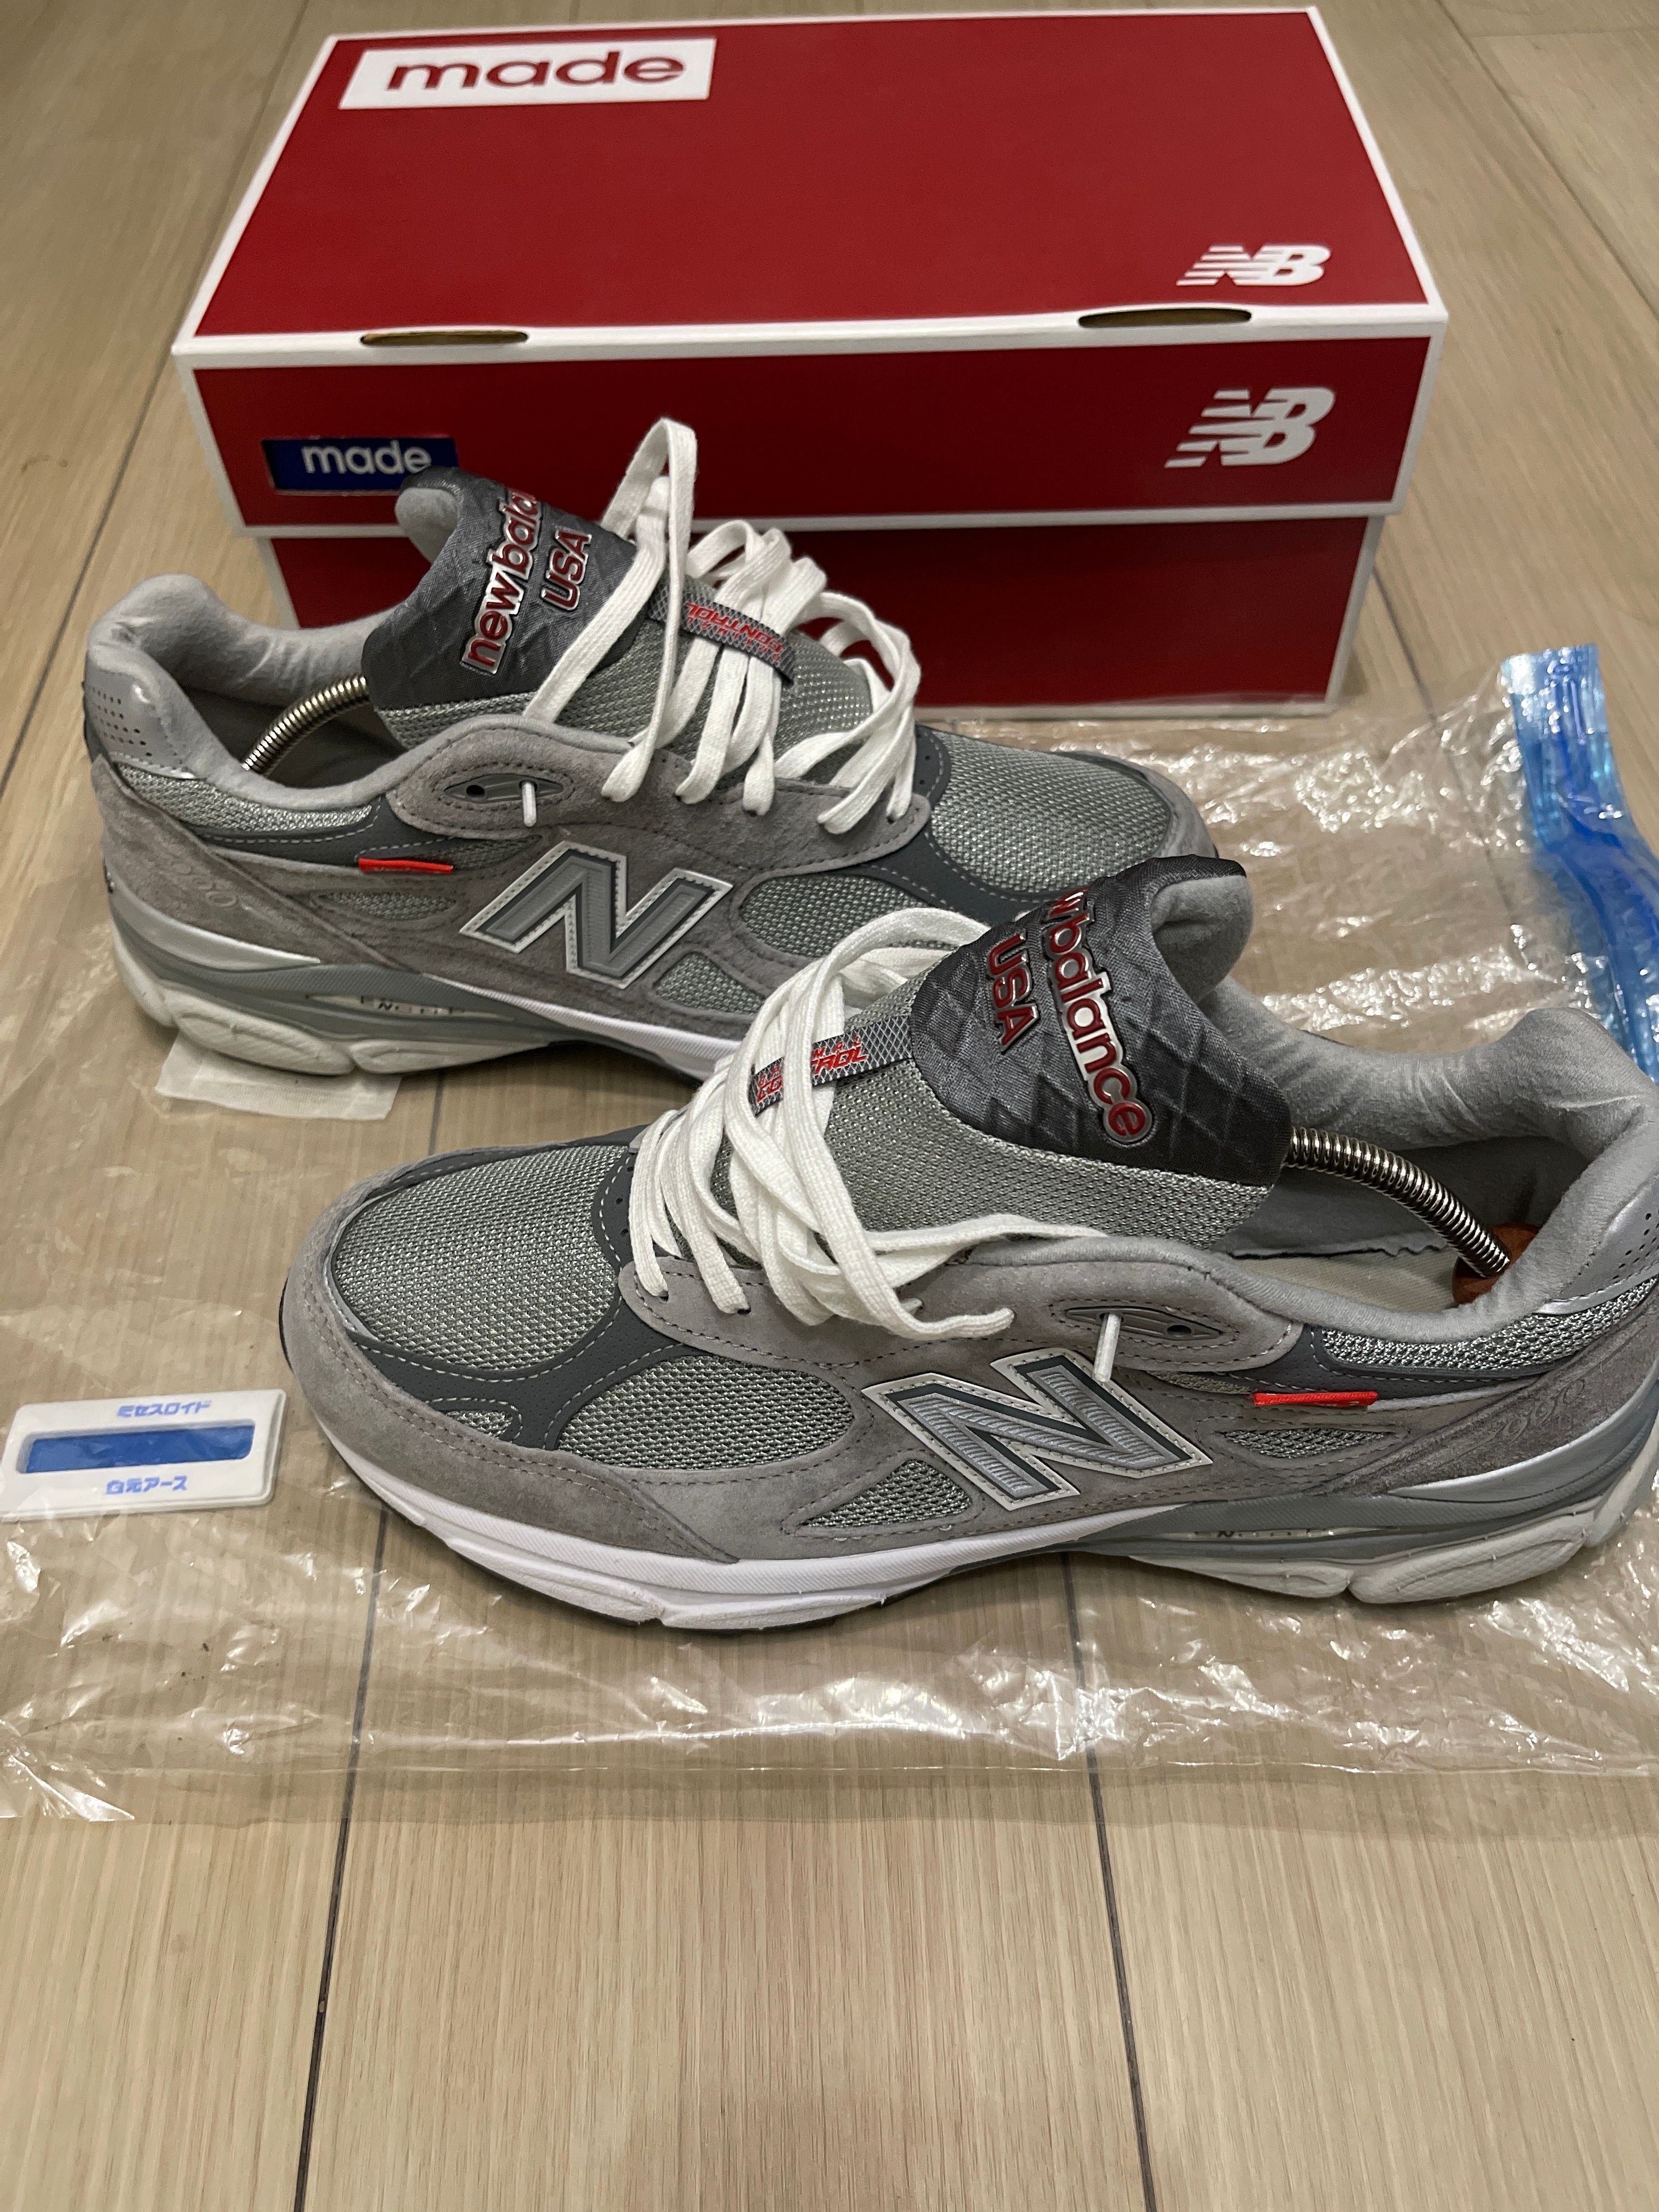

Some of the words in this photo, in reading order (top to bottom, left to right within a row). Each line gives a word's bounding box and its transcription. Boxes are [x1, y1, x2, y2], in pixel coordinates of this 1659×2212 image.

[386, 51, 684, 91] made
[1176, 244, 1331, 286] NB
[1164, 386, 1336, 469] NB
[301, 439, 432, 475] made
[541, 528, 591, 611] USA
[685, 602, 782, 653] CONTROL
[988, 933, 1039, 1049] USA
